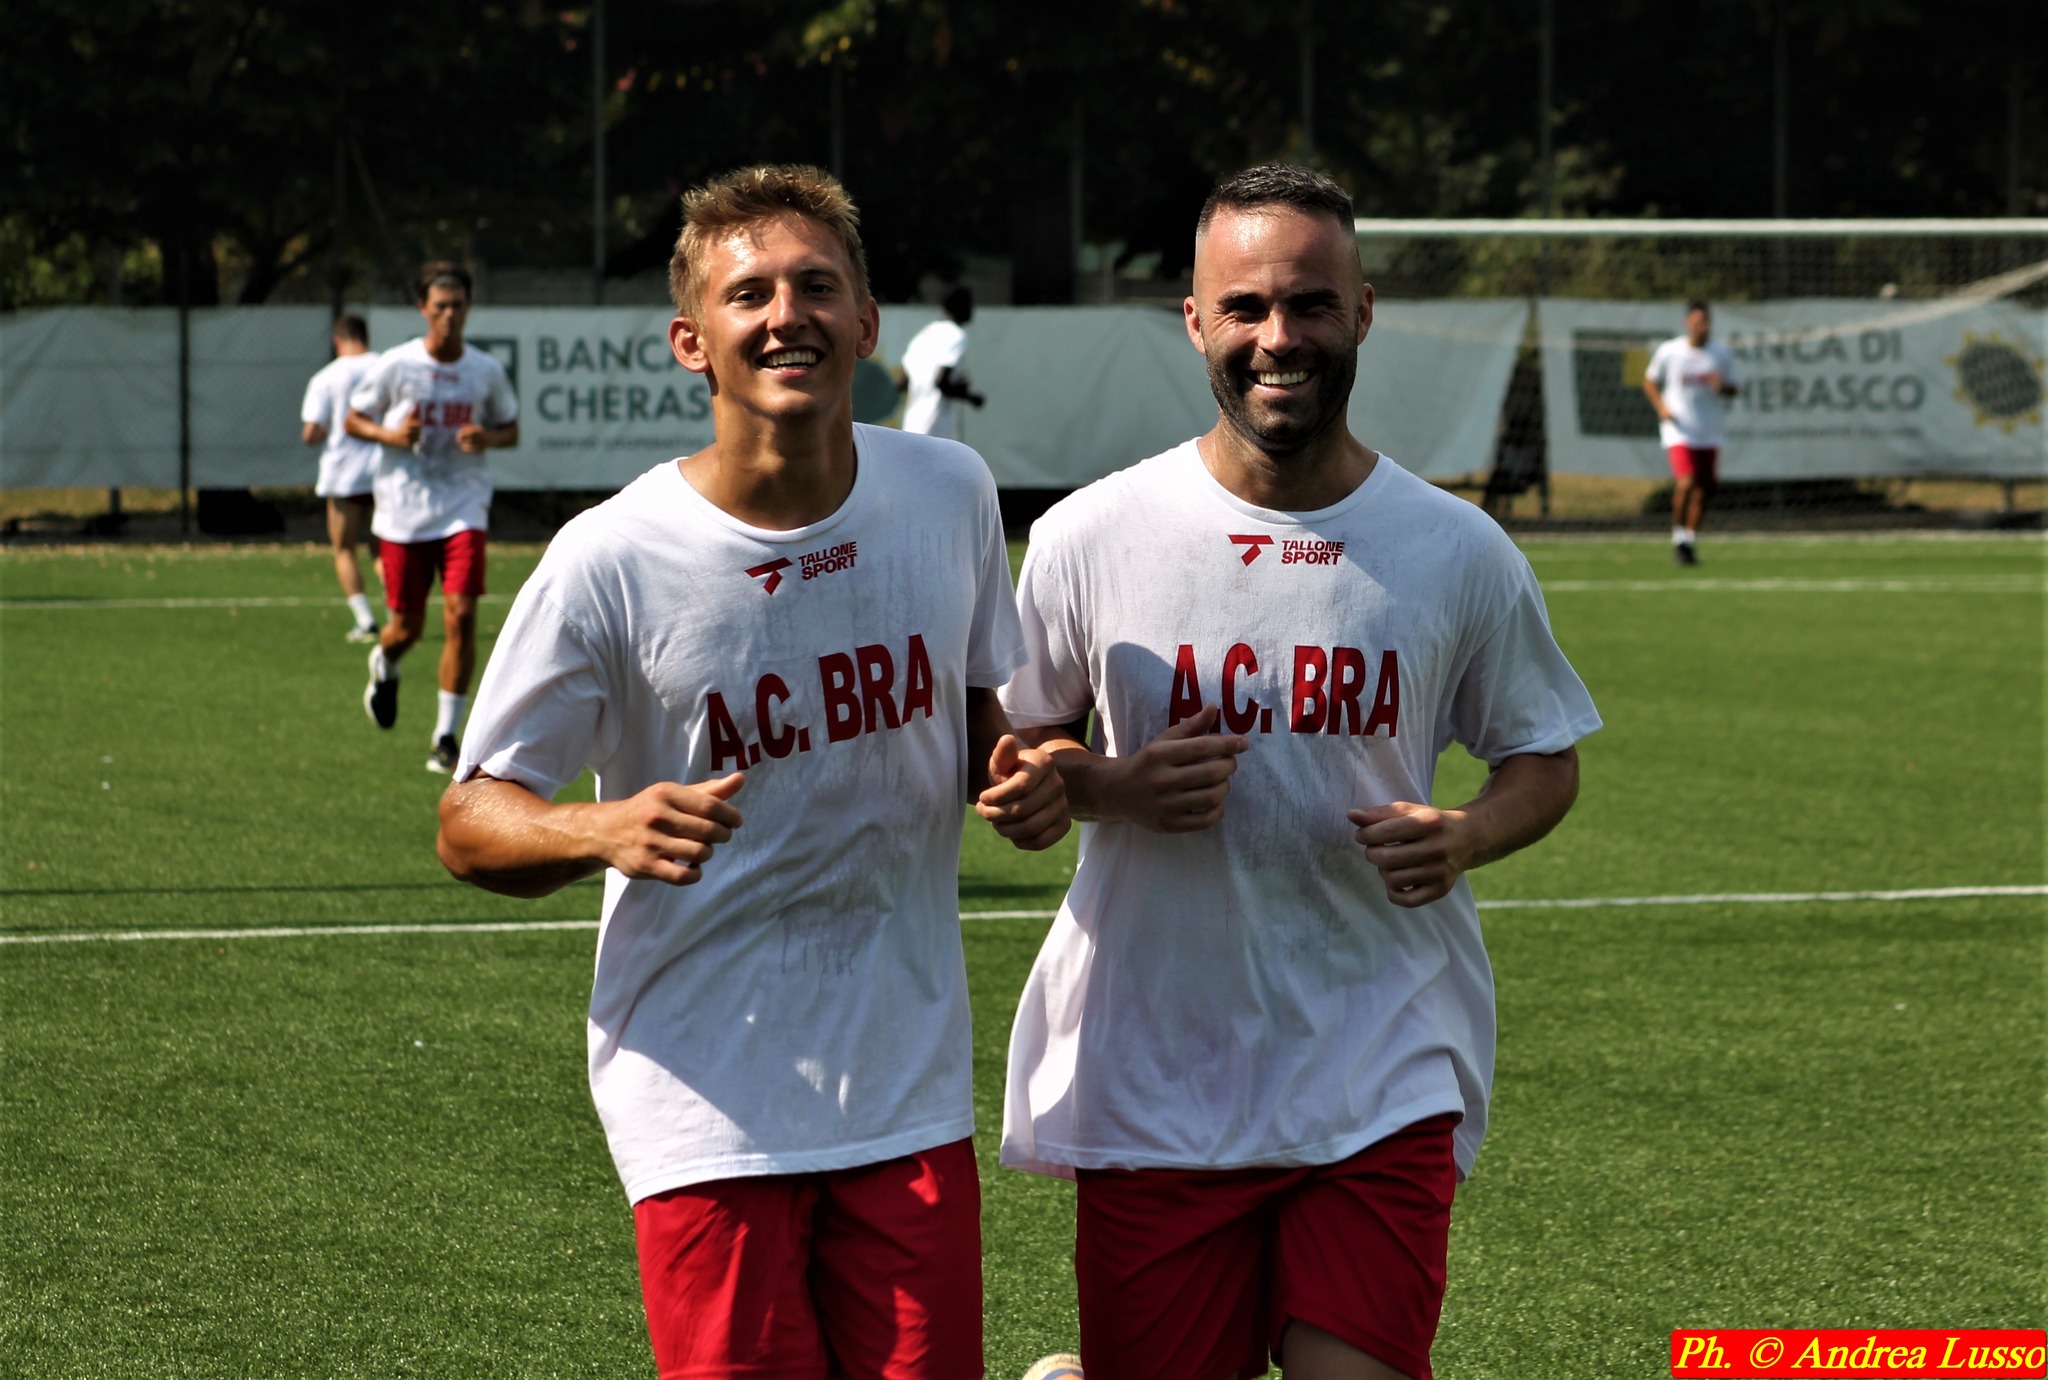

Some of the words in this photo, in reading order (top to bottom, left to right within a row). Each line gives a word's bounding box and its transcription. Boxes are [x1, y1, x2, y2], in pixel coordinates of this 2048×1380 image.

[1729, 328, 1847, 363] ANCA
[1860, 329, 1903, 363] DI
[537, 383, 709, 422] CHERAS
[1725, 373, 1926, 412] HERASCO
[798, 541, 857, 566] TALLONE
[1281, 540, 1345, 552] TALLONE
[1281, 551, 1342, 565] SPORT
[801, 553, 857, 580] SPORT
[707, 672, 811, 771] A.C.
[818, 634, 933, 743] BRA
[1290, 645, 1399, 738] BRA
